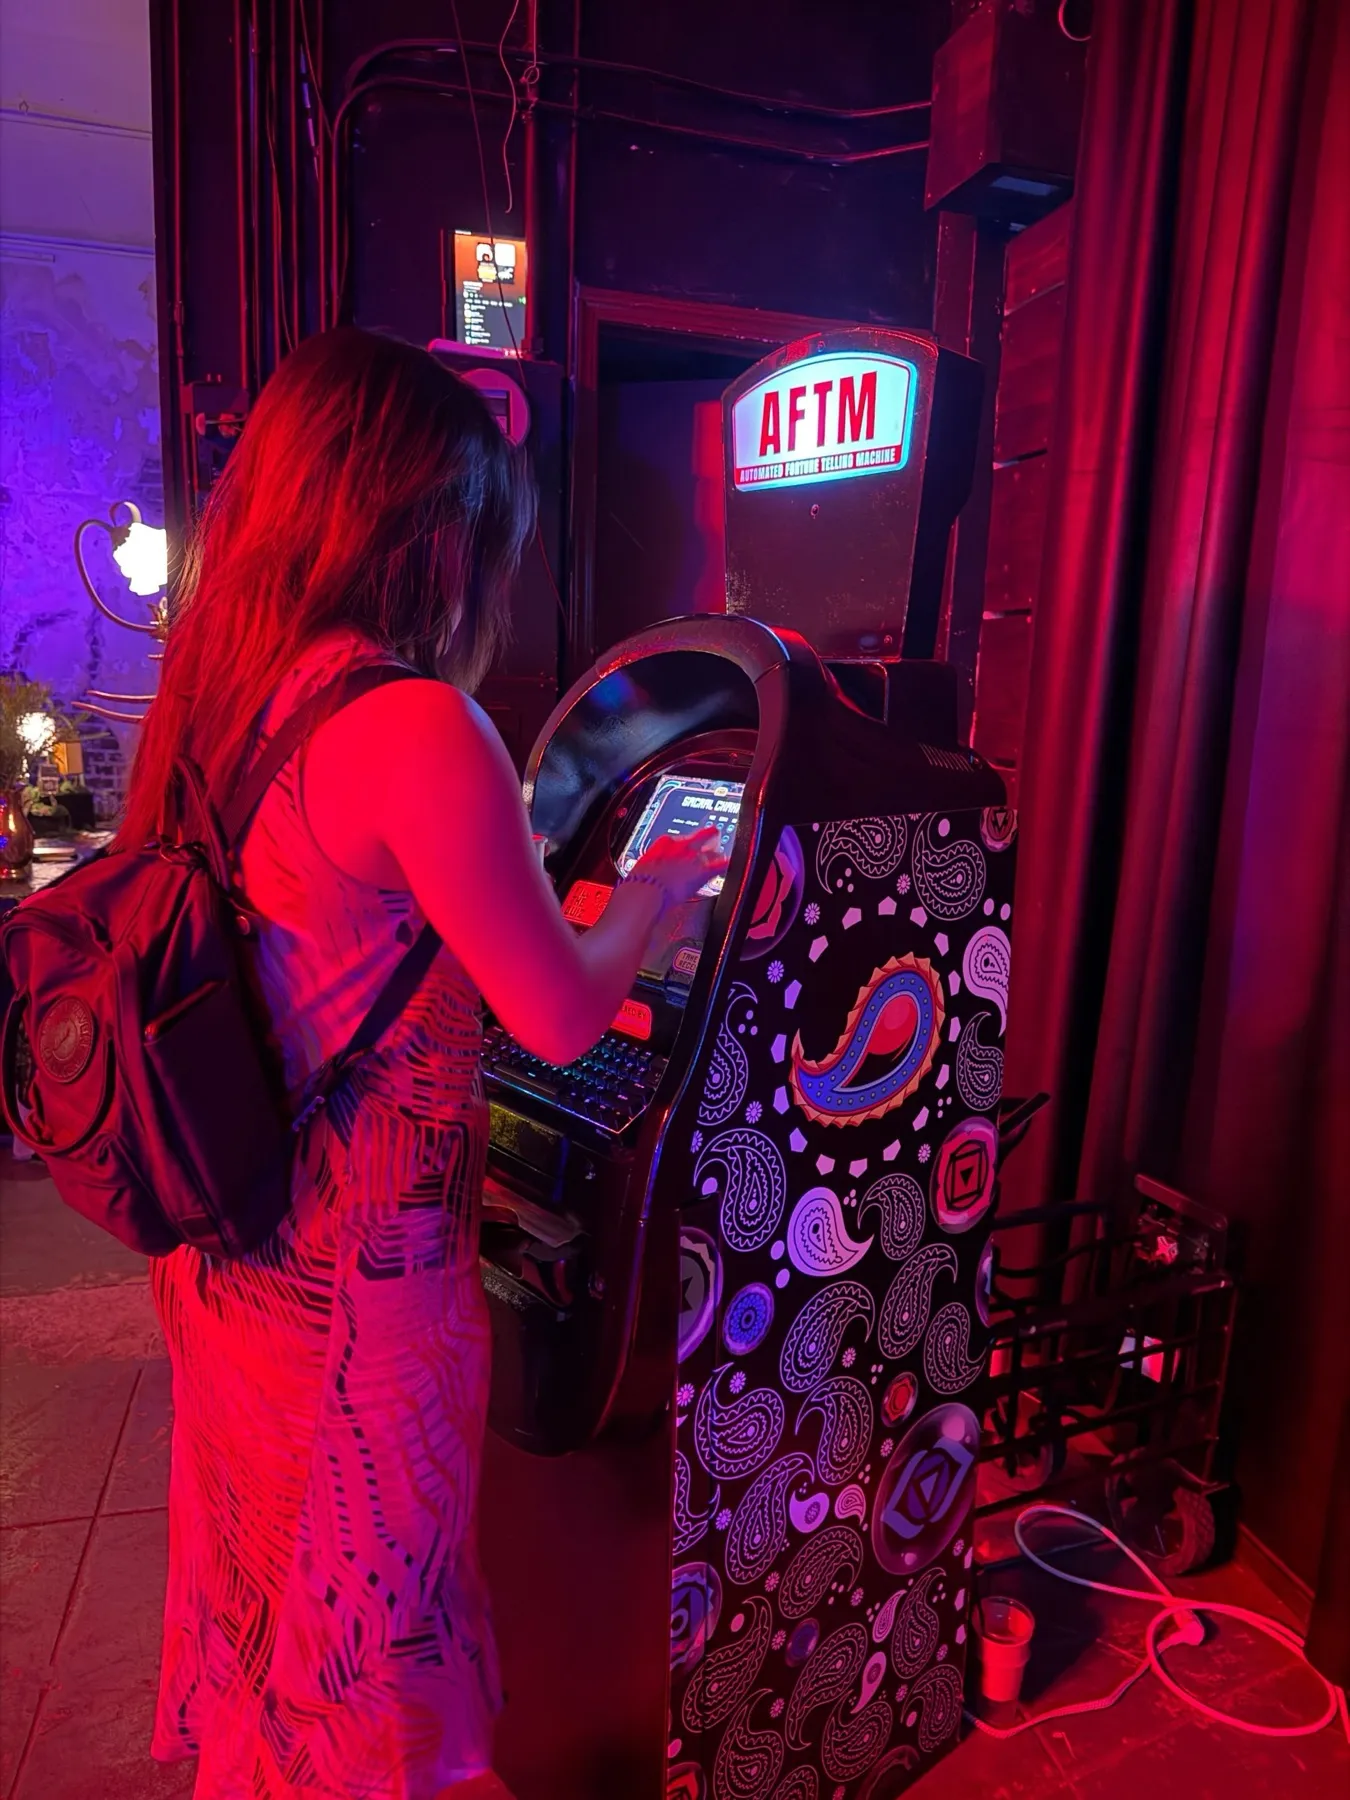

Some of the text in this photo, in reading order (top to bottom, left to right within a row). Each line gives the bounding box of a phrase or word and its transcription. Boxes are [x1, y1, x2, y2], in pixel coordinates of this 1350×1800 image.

[759, 371, 877, 456] AFTM
[740, 448, 896, 482] AUTOMATED FORTUNE TELLING MACHINE
[682, 796, 741, 814] SACRAL CHAK
